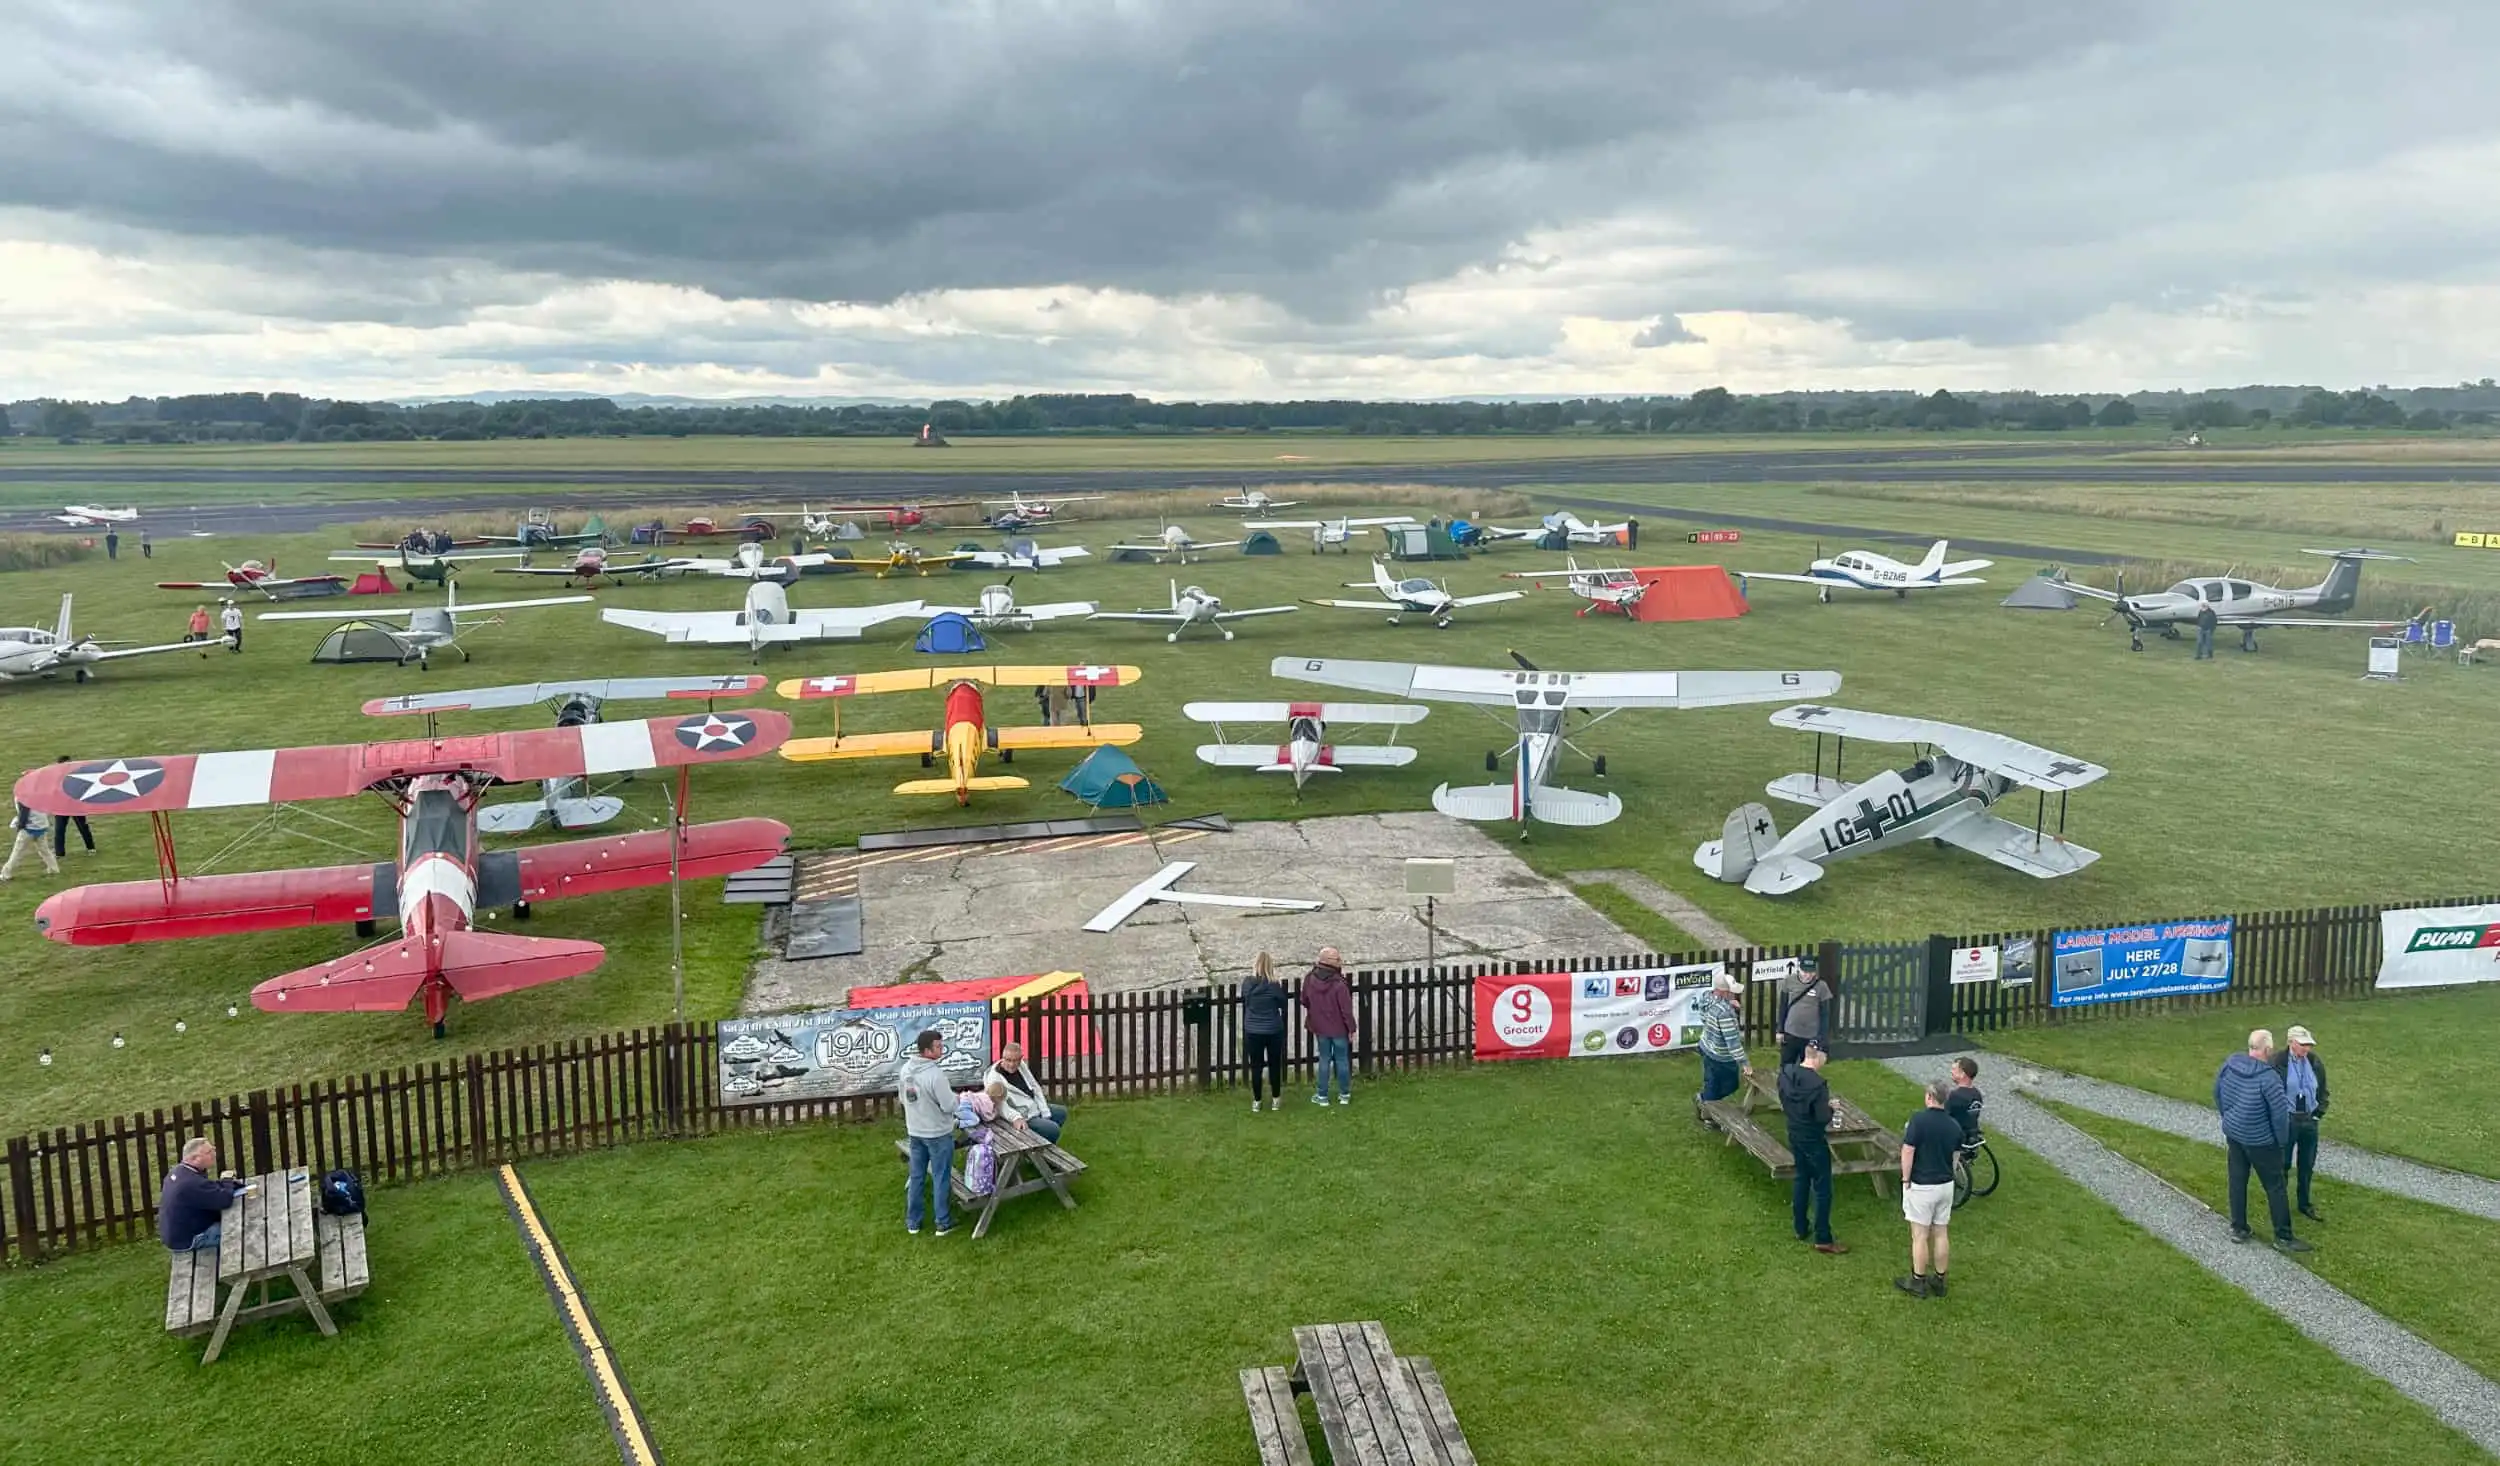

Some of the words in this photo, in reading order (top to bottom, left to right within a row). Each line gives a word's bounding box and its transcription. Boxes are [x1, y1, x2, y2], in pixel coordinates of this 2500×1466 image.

[2471, 535, 2479, 544] B
[2491, 536, 2499, 545] A
[1305, 660, 1324, 671] G
[1781, 672, 1801, 685] G
[1820, 817, 1857, 853] LG
[1887, 787, 1918, 819] 01
[2108, 927, 2158, 945] MODEL
[2162, 921, 2231, 940] AIRSHOW
[2414, 930, 2477, 948] PUMA
[2126, 949, 2161, 963] HERE
[1755, 965, 1784, 975] Airfield
[2106, 967, 2139, 981] JULY
[2141, 963, 2178, 977] 27/28
[1676, 973, 1712, 986] nixons
[1504, 1024, 1544, 1035] Grocott
[820, 1029, 890, 1058] 1940
